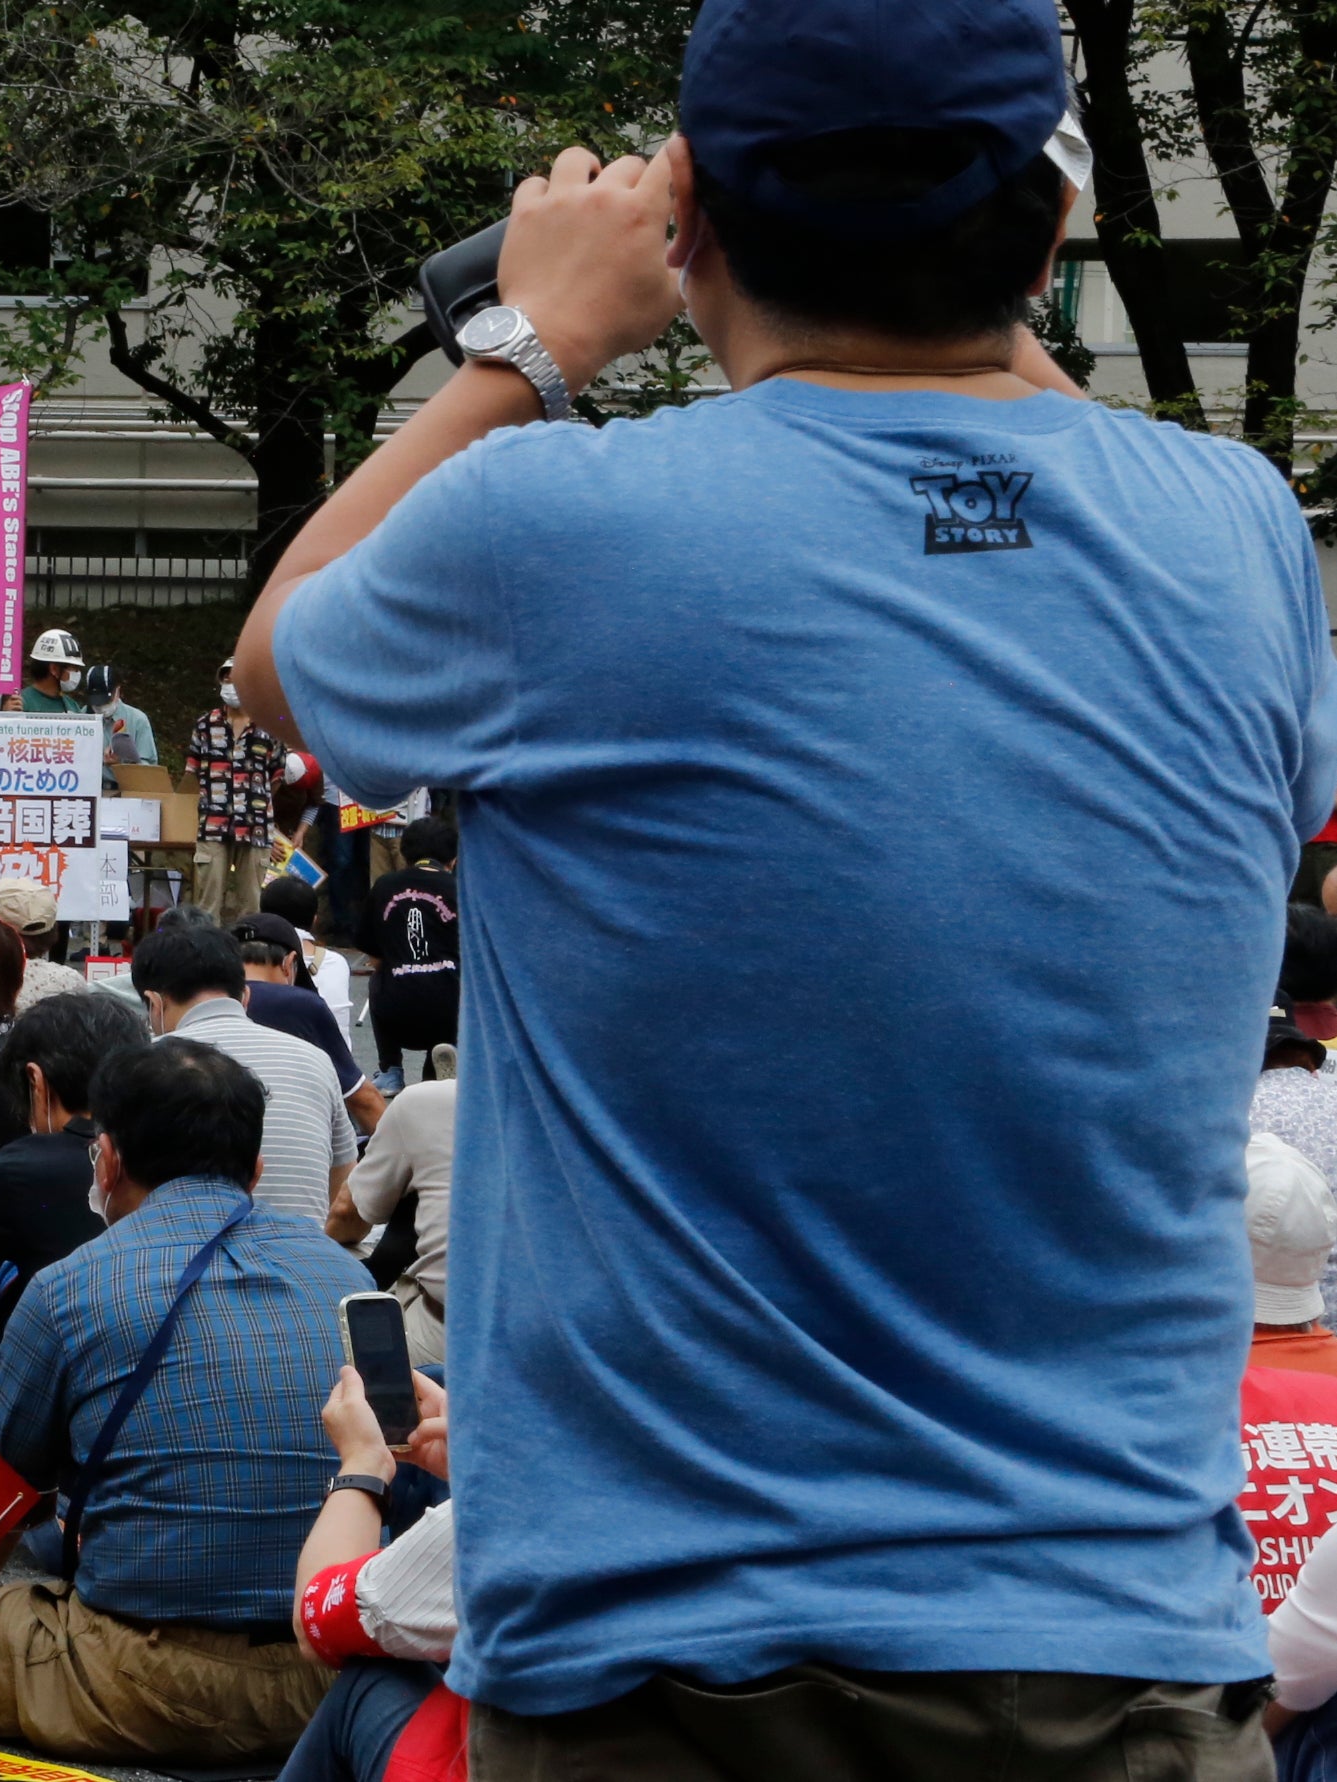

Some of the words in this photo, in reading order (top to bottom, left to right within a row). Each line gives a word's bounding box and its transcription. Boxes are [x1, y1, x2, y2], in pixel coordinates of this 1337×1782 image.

[971, 453, 1018, 466] PIXAR
[909, 471, 1034, 525] TOY
[4, 517, 20, 582] State
[935, 527, 1020, 543] STORY
[0, 588, 17, 682] Funeral
[17, 724, 53, 736] funeral
[57, 725, 71, 736] for
[75, 726, 95, 737] Abe
[1241, 1421, 1337, 1472] 連帯
